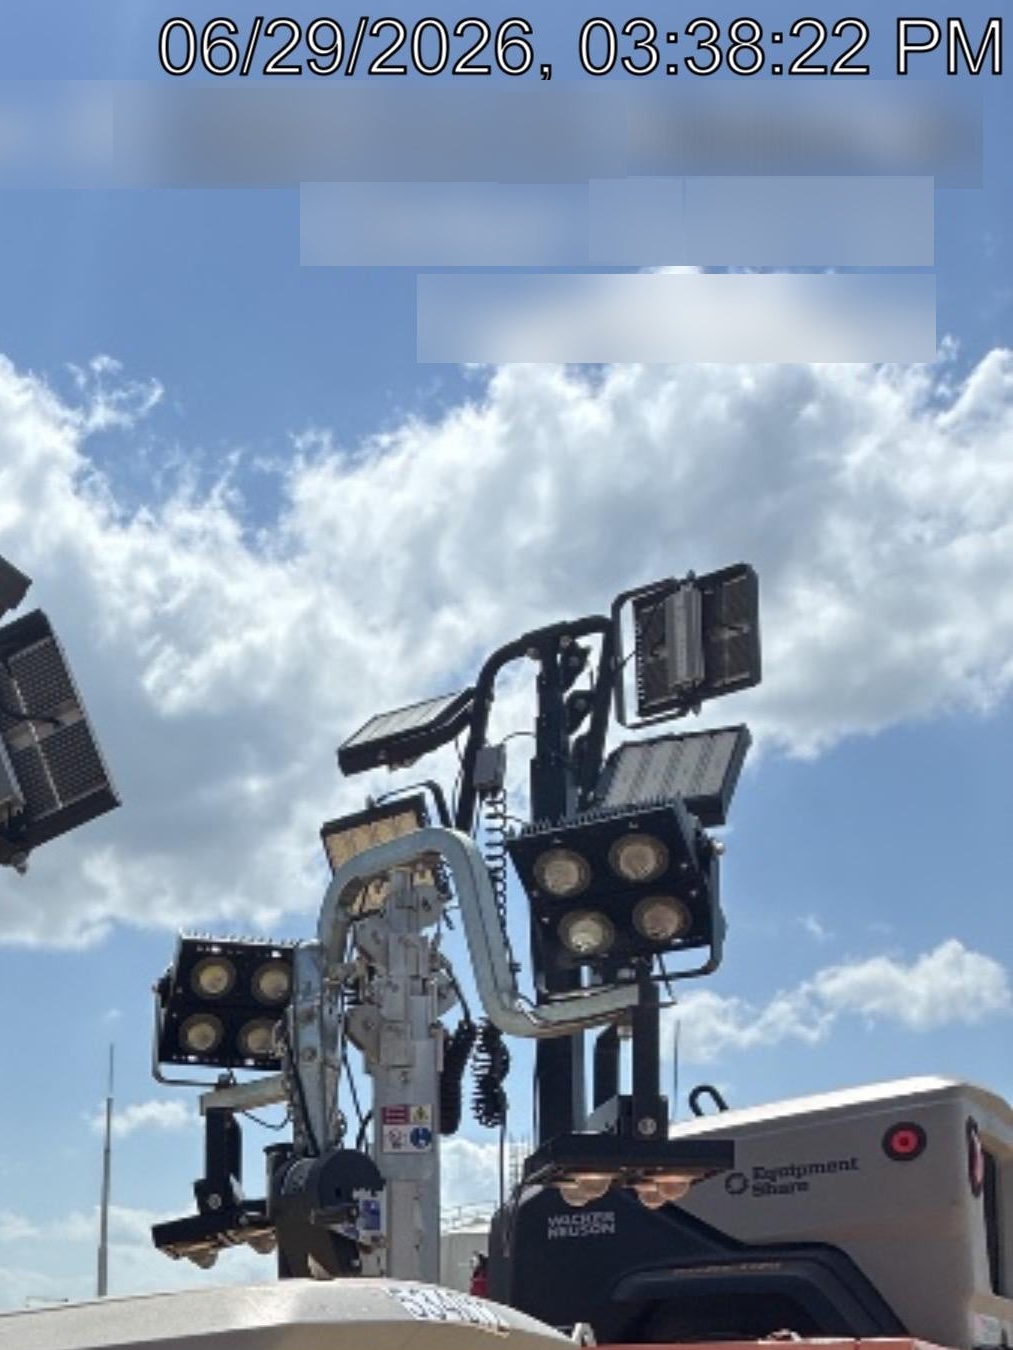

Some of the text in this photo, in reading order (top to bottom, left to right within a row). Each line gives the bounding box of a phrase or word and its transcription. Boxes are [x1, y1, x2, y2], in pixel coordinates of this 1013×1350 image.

[752, 1157, 858, 1182] Equipment
[752, 1178, 809, 1197] Share
[547, 1211, 615, 1227] WACKER
[547, 1224, 616, 1239] NEUSON
